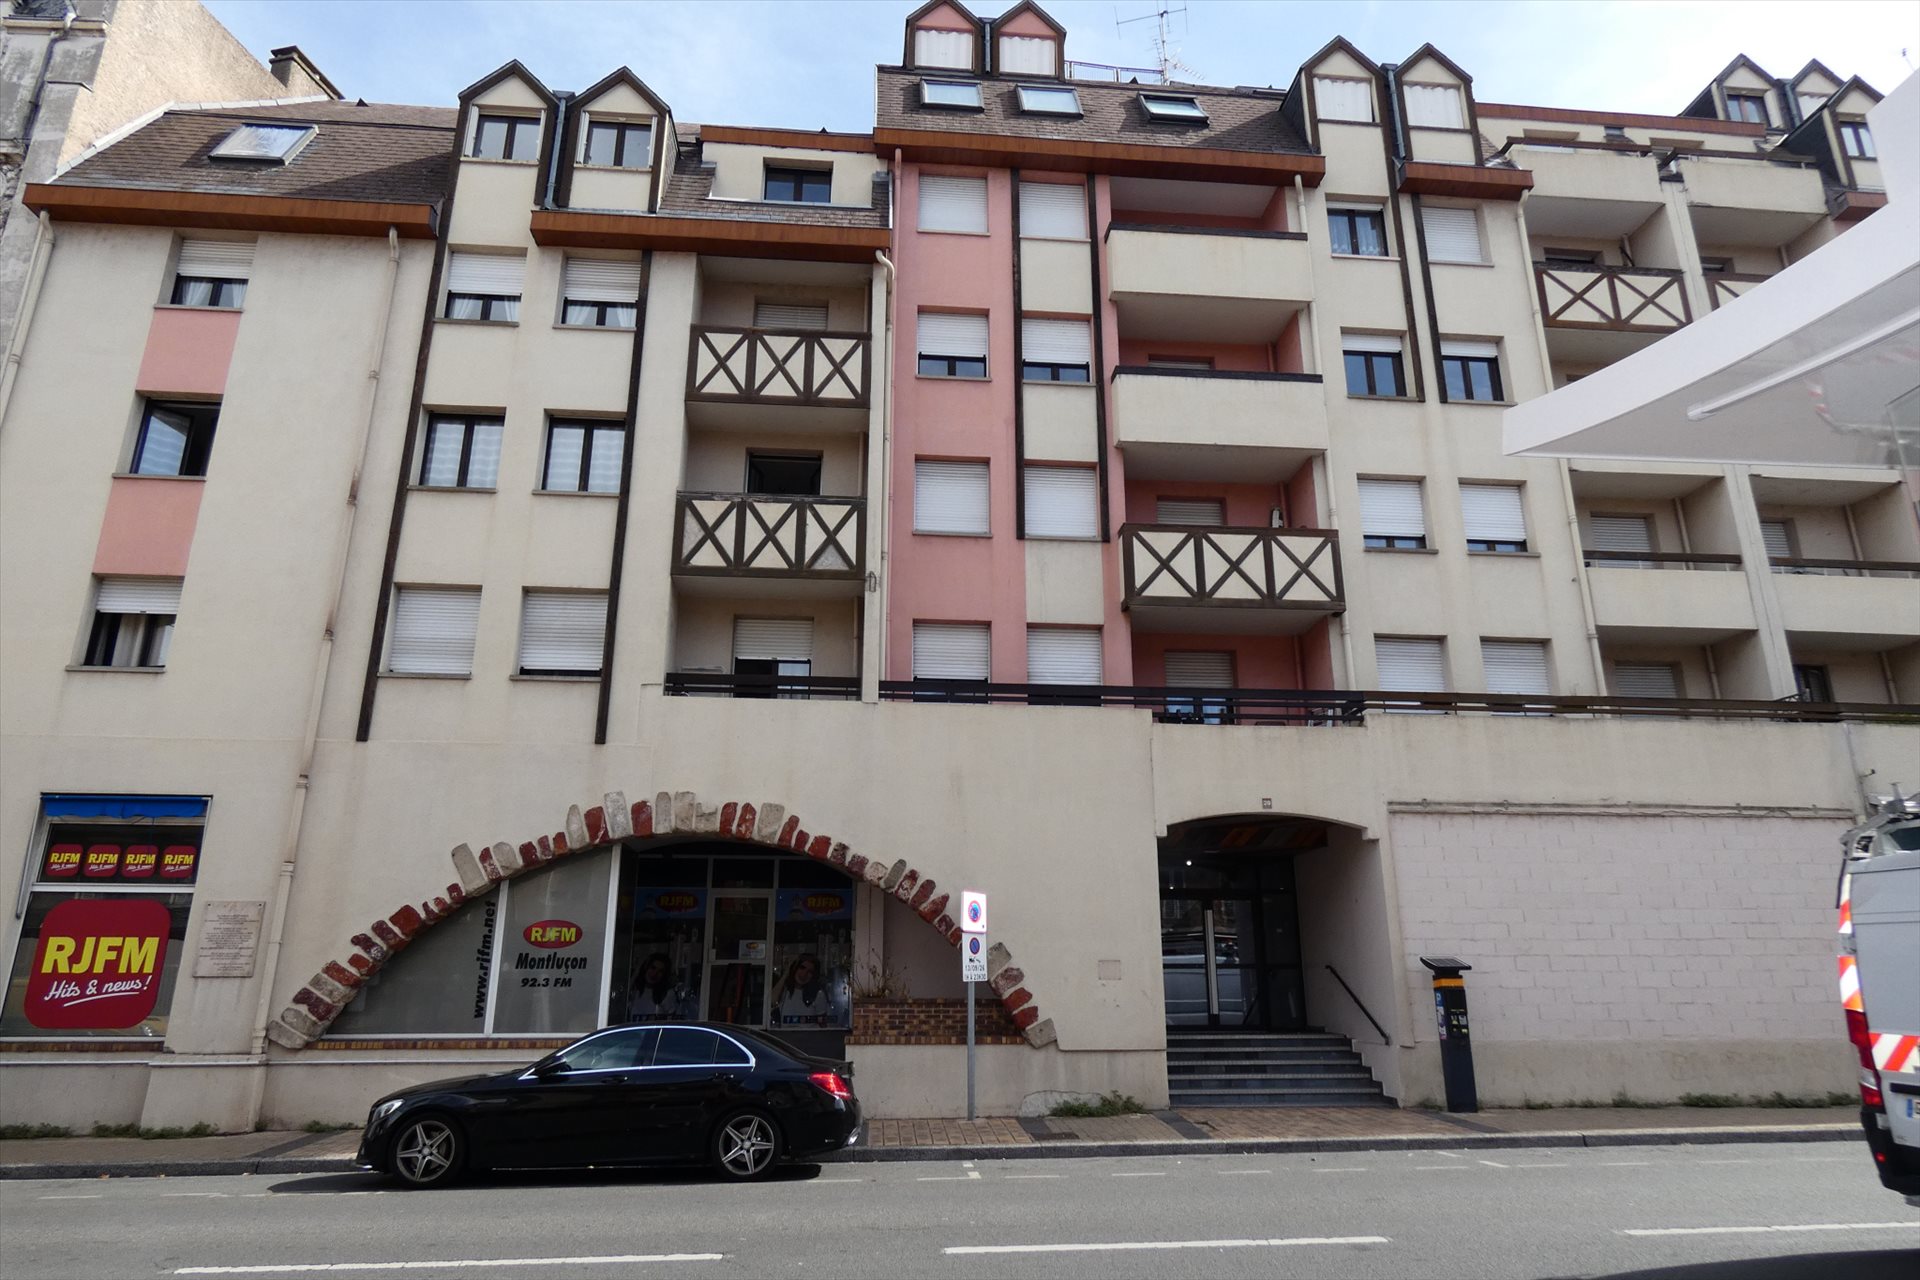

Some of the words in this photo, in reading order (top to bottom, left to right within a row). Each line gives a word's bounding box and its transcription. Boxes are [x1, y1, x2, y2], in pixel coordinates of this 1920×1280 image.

[50, 853, 80, 864] RJFM
[88, 853, 118, 864] RJFM
[126, 854, 156, 865] RJFM
[164, 854, 194, 865] RJFM
[530, 927, 577, 942] RJFM
[41, 936, 160, 974] RJFM
[474, 901, 496, 1019] www.rjfm.net
[515, 952, 588, 974] Montluçon
[44, 980, 80, 1000] Hits
[86, 979, 98, 995] &
[102, 975, 153, 992] news!
[521, 977, 549, 988] 92.3
[553, 977, 572, 988] FM
